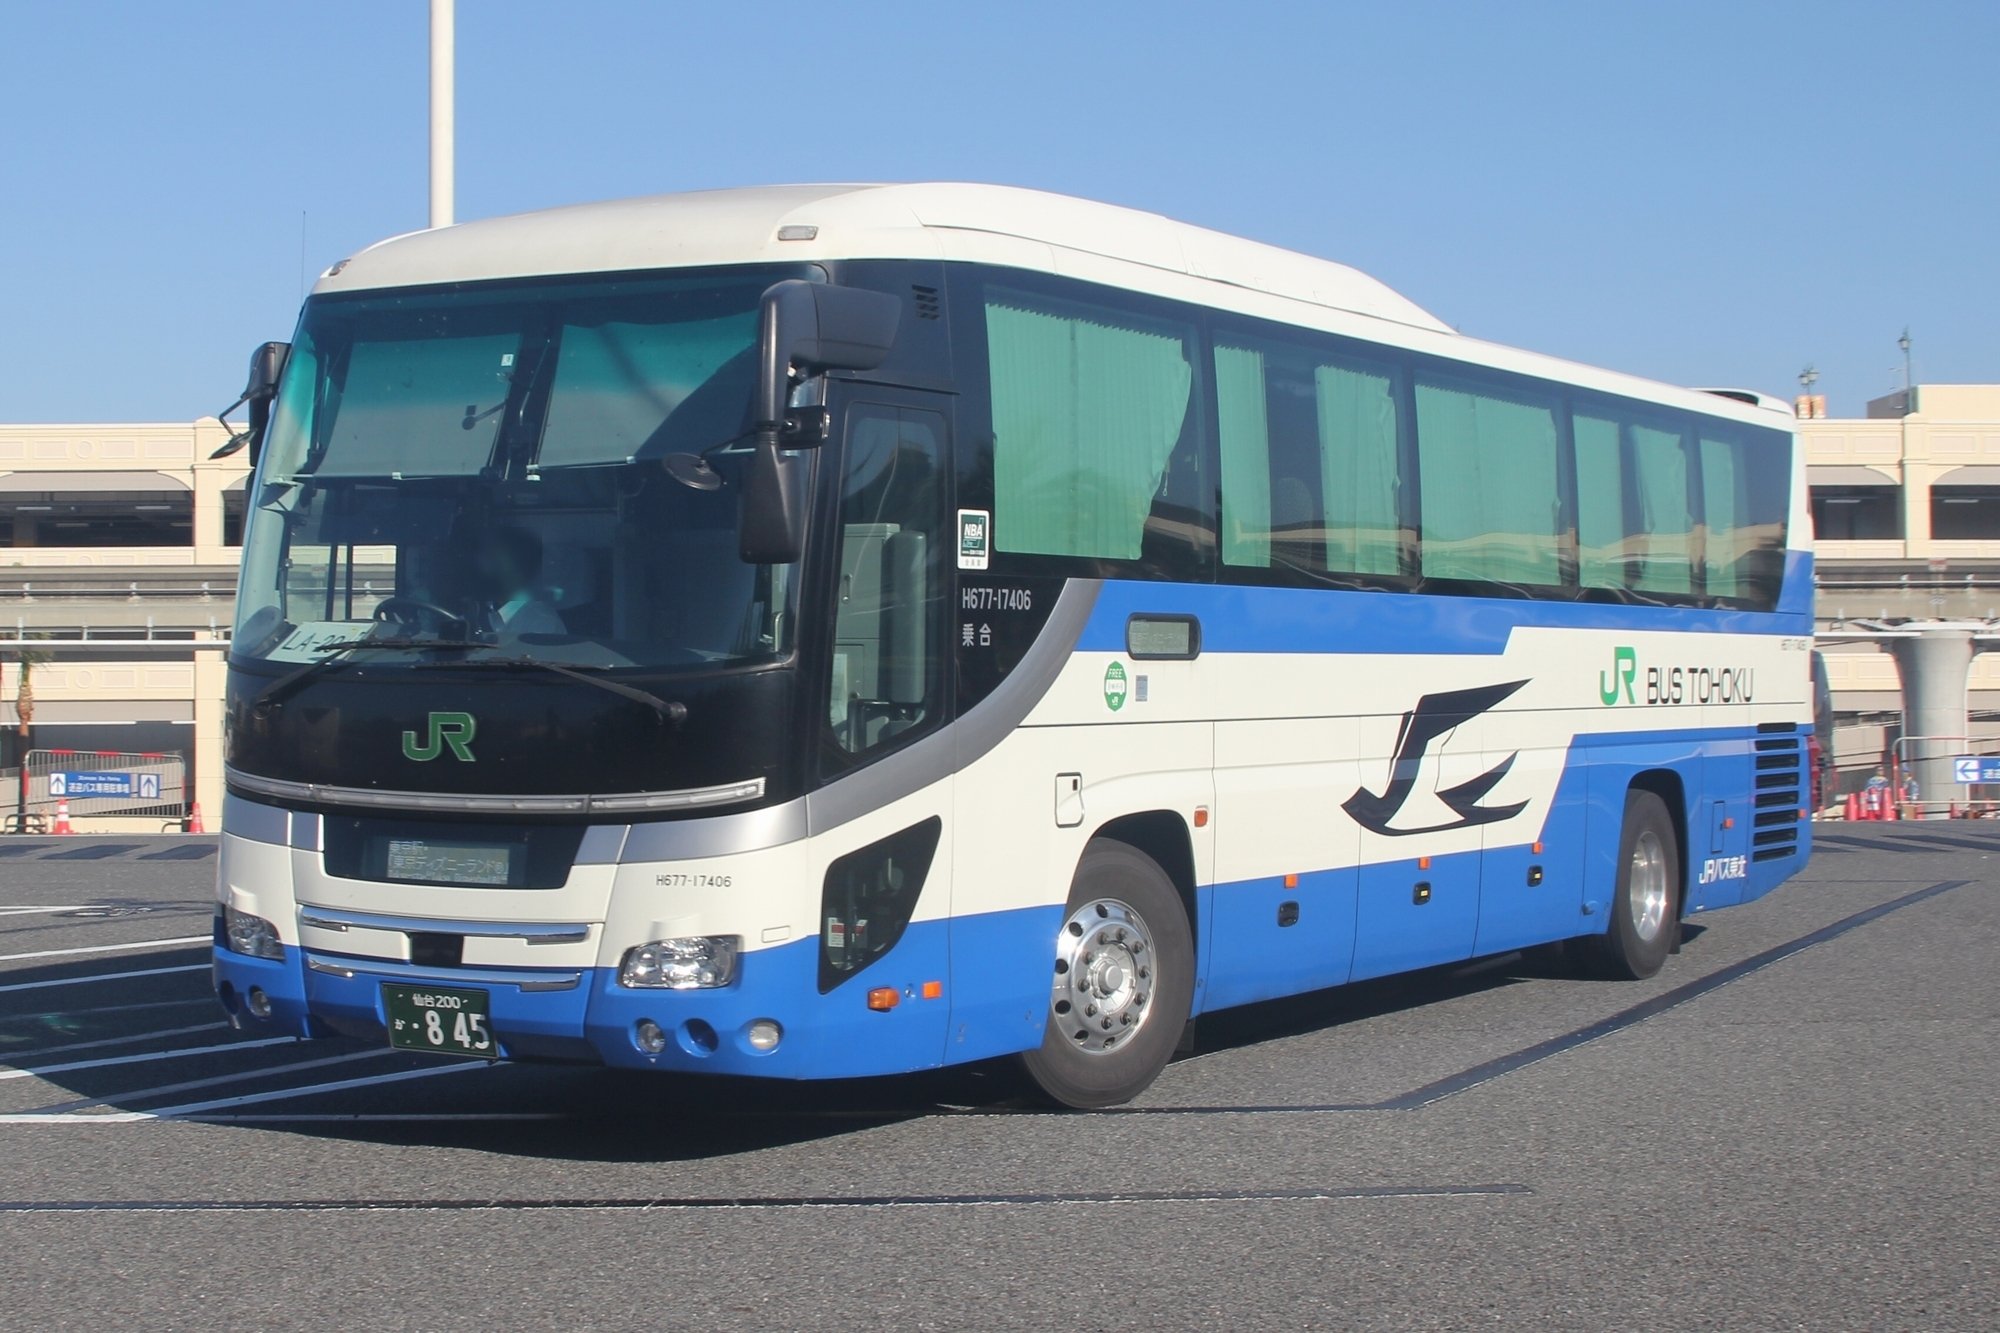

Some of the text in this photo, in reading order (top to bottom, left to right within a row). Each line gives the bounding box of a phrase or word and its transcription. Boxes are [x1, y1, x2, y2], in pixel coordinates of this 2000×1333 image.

[963, 523, 983, 537] NBA
[962, 587, 1032, 610] H677-17406
[962, 623, 992, 647] 乗合
[1108, 668, 1123, 678] FREE
[1599, 646, 1755, 706] JR BUS TOHOKU
[401, 711, 476, 762] JR
[655, 874, 733, 888] H677-17406
[1698, 855, 1747, 884] JRバス東北
